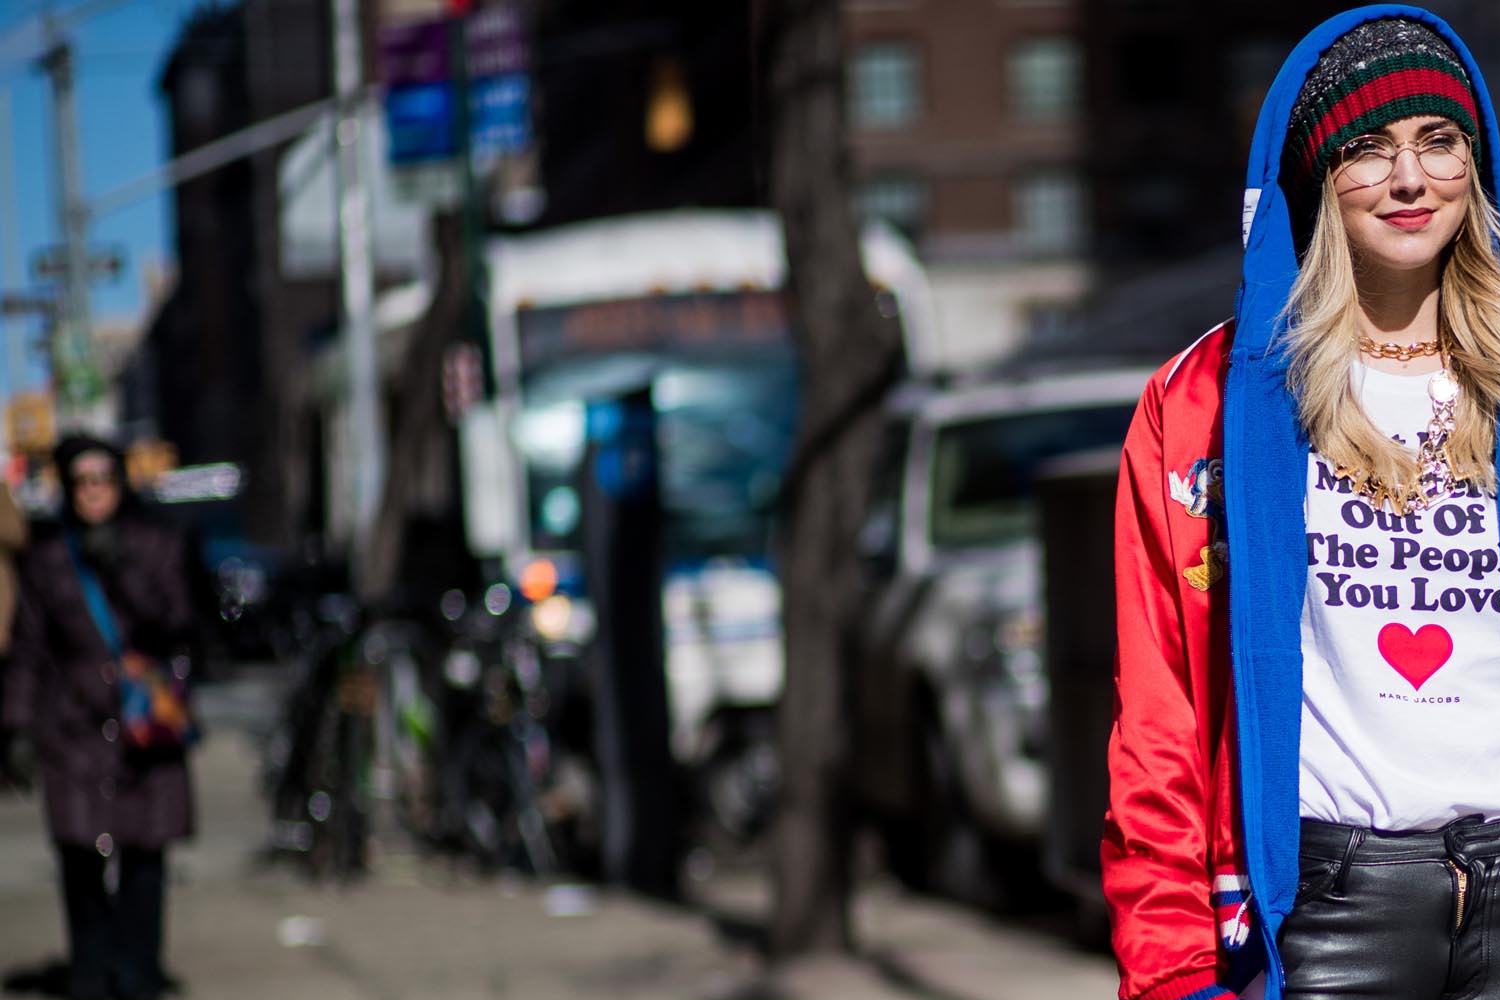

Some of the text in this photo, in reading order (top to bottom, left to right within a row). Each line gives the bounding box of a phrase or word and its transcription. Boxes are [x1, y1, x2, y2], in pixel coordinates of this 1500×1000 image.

[1341, 500, 1486, 536] Out Of
[1306, 533, 1379, 569] The
[1316, 572, 1399, 610] You
[1379, 692, 1460, 704] MARC JACOBS
